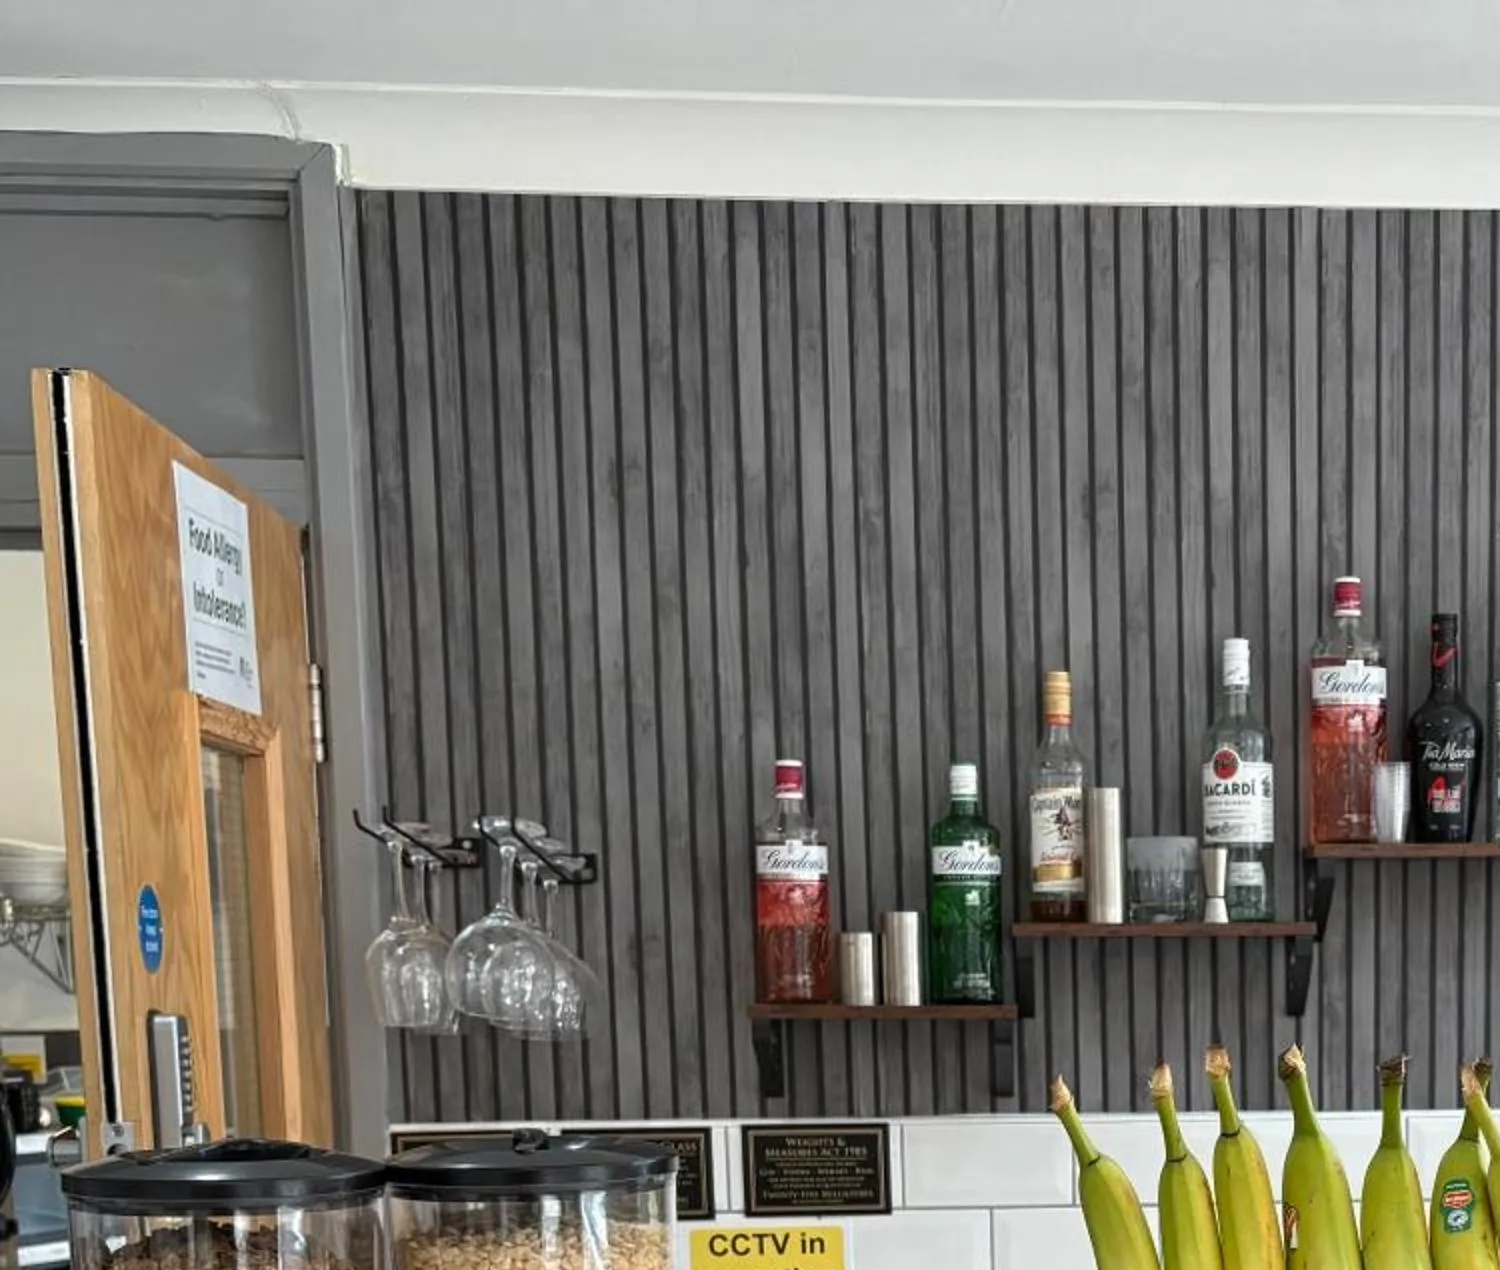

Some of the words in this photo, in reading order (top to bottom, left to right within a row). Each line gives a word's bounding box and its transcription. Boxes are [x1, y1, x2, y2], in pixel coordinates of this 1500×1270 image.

[188, 516, 212, 557] Food
[213, 529, 242, 576] Allergy
[708, 1232, 790, 1257] CCTV
[800, 1232, 825, 1255] in
